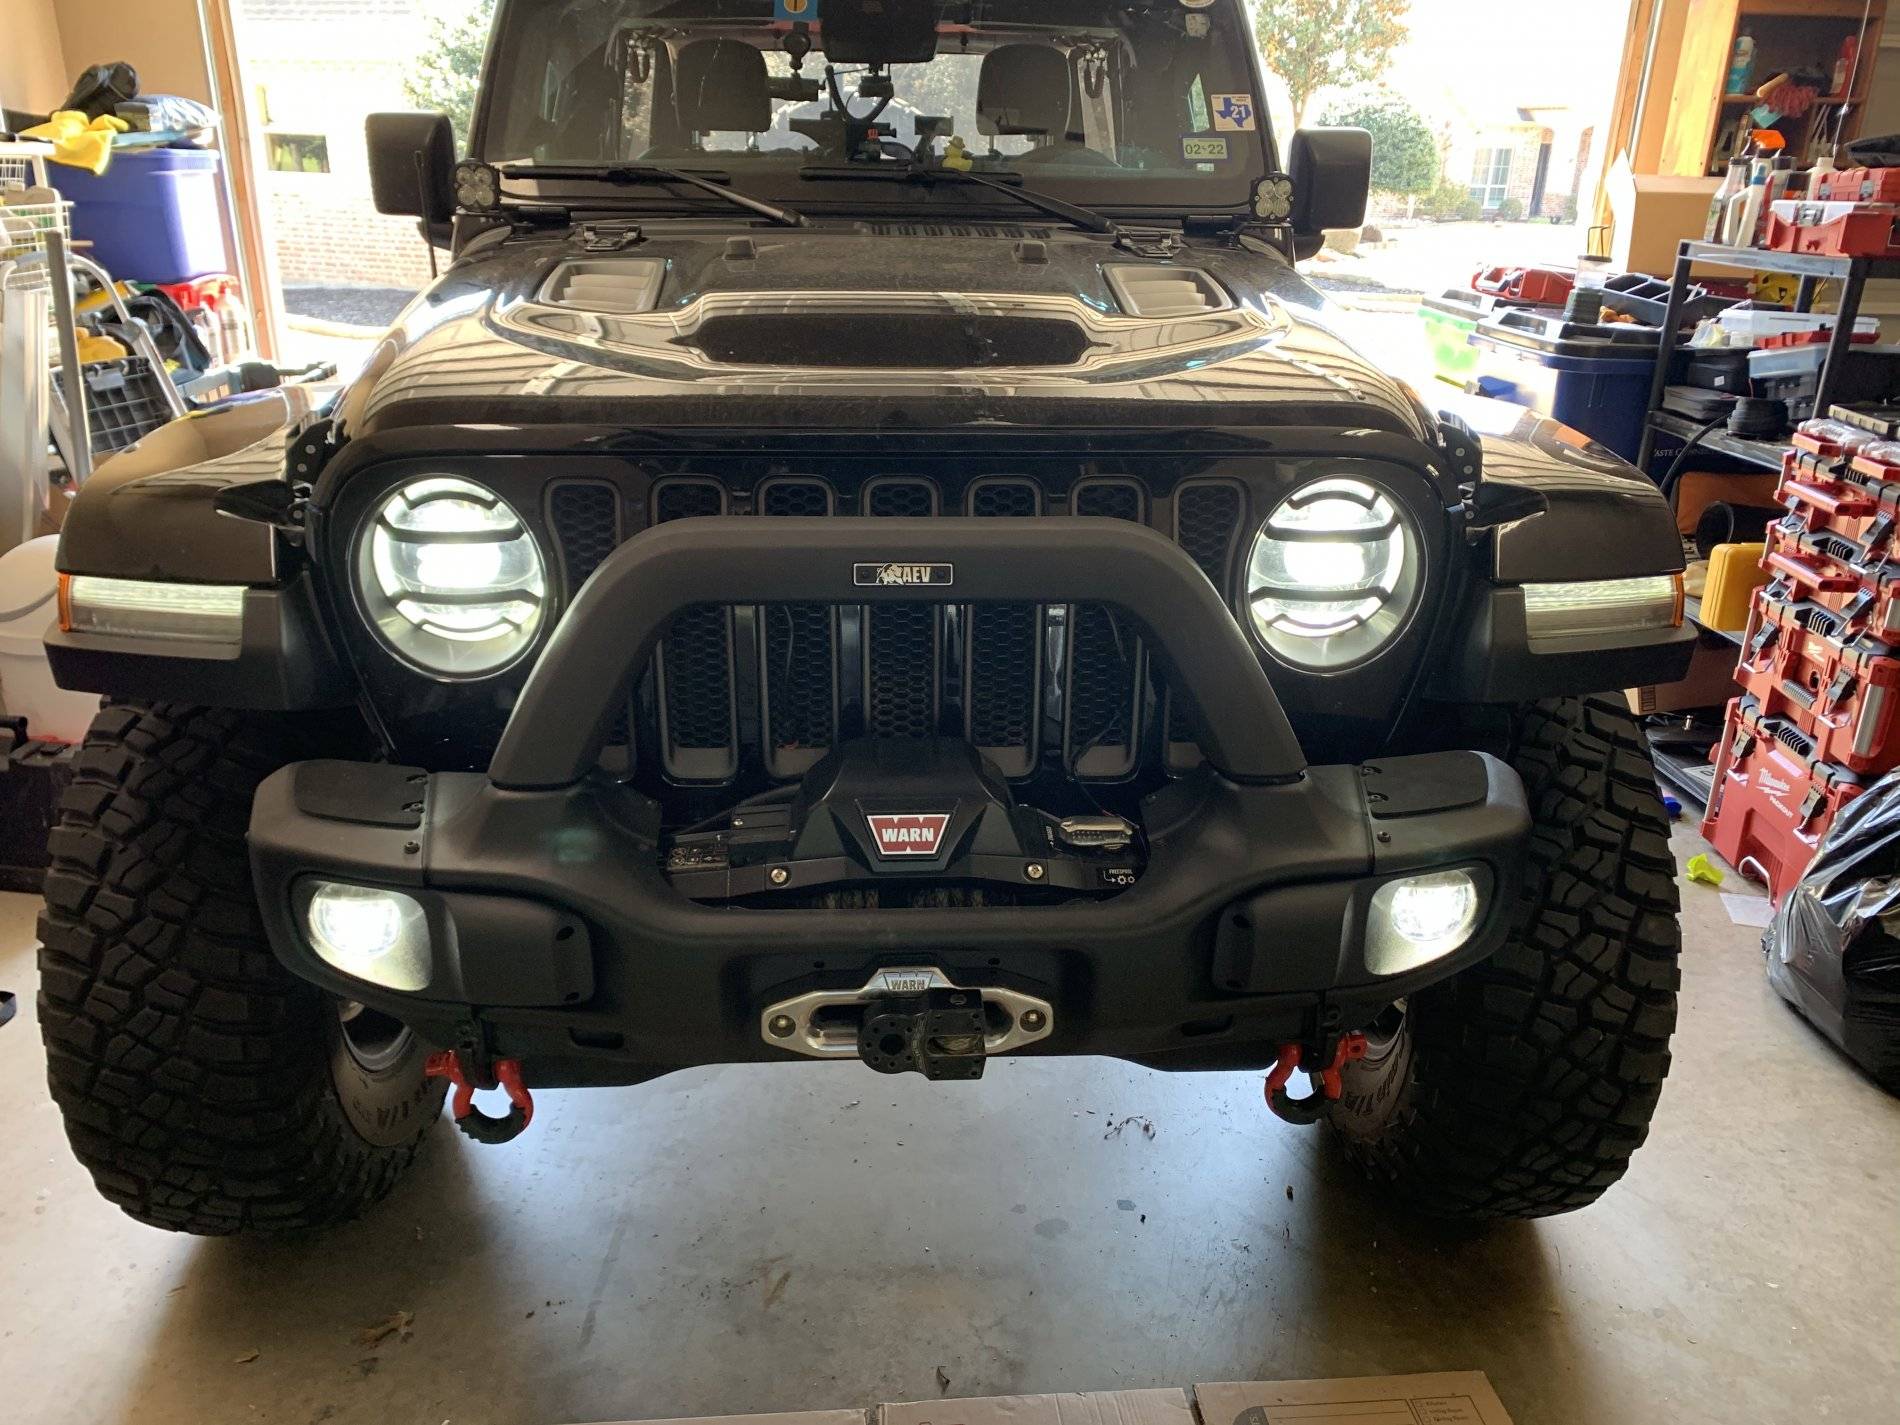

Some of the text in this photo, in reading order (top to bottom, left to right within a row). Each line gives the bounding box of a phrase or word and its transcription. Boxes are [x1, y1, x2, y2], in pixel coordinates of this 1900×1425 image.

[1231, 105, 1246, 118] 21
[903, 566, 931, 583] AEV
[881, 827, 935, 843] WARN
[890, 979, 926, 990] WARN
